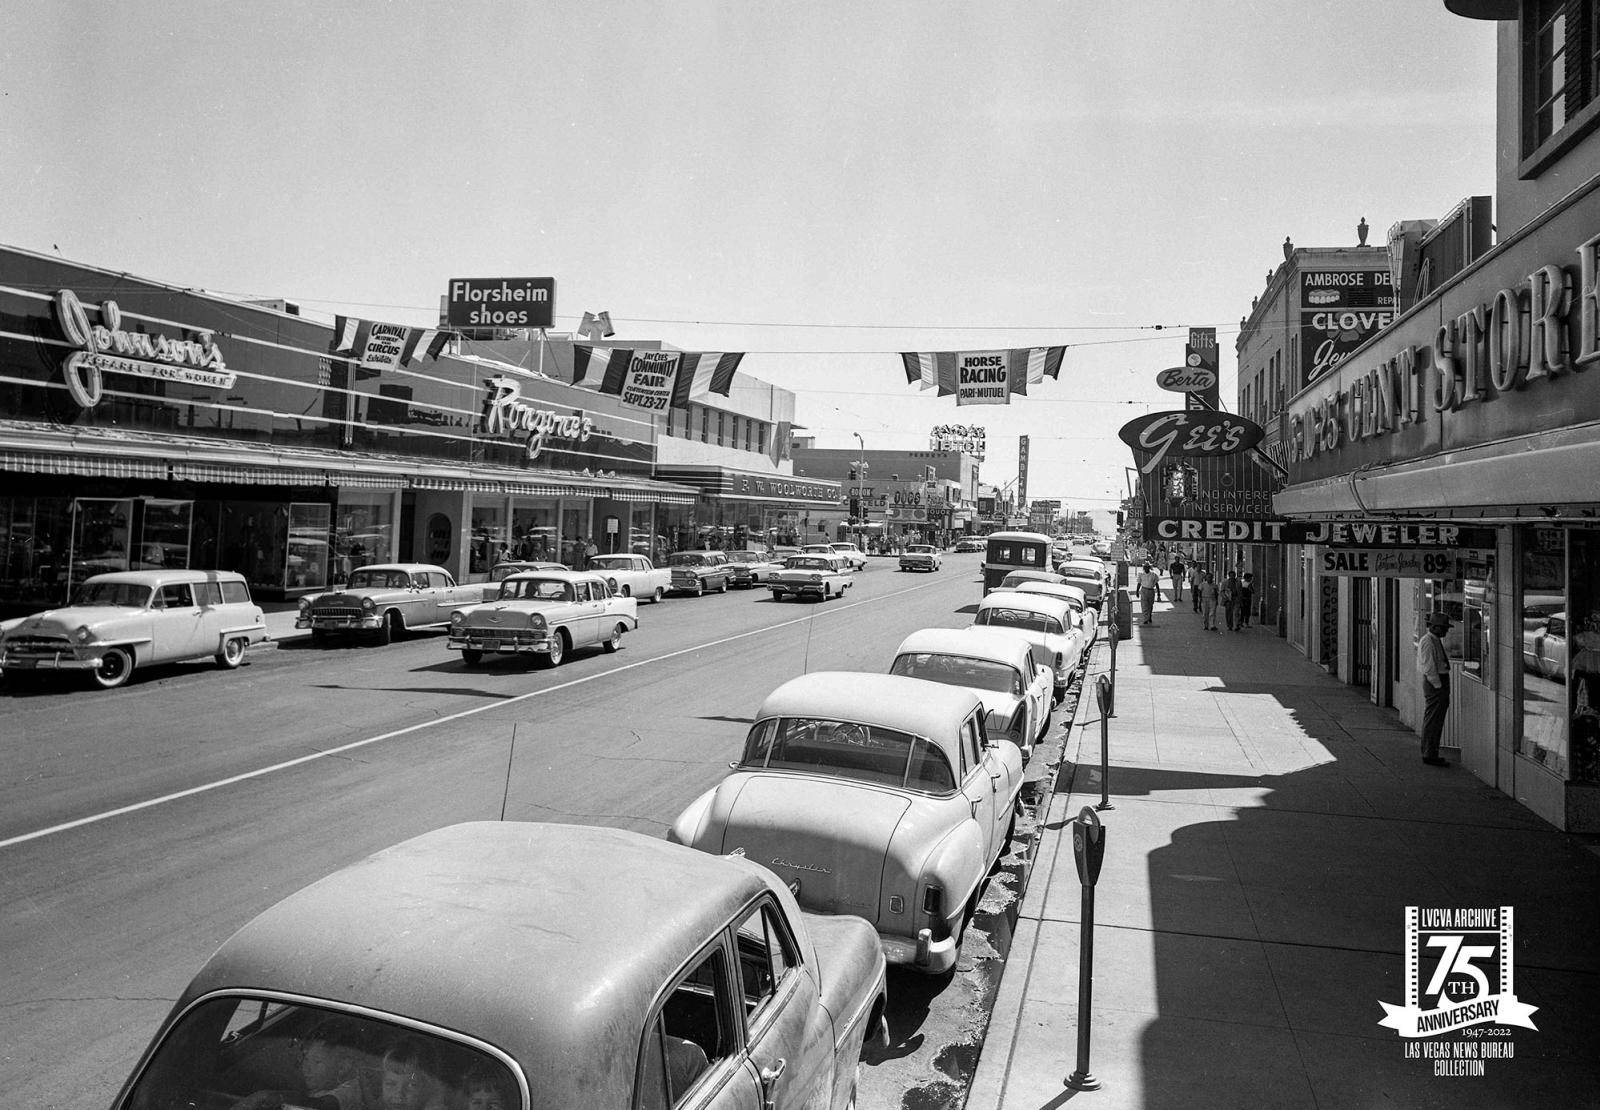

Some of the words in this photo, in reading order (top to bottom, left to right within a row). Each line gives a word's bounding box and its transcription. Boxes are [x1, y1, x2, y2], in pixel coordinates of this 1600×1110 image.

[1305, 273, 1364, 286] AMBROSE
[453, 281, 548, 302] Florsheim
[469, 304, 528, 324] shoes
[371, 323, 406, 340] CARNIVAL
[1190, 331, 1214, 349] Gifts
[56, 288, 226, 408] Johnson's
[367, 343, 400, 355] CIRCUS
[631, 357, 678, 377] COMMUNITY
[964, 356, 1002, 367] HORSE
[152, 366, 176, 378] FOR
[185, 371, 226, 386] WOMEN
[633, 373, 666, 387] FAIR
[960, 365, 1006, 383] RACING
[1163, 369, 1213, 388] Berta
[960, 388, 1005, 398] PARI-MUTUEL
[1018, 436, 1027, 504] GAMBLING
[770, 481, 824, 498] WOOLWORTH
[1202, 490, 1219, 499] NO
[1213, 503, 1262, 514] SERVICE
[1157, 519, 1287, 541] CREDIT
[1305, 523, 1459, 545] JEWELER
[1324, 552, 1369, 571] SALE
